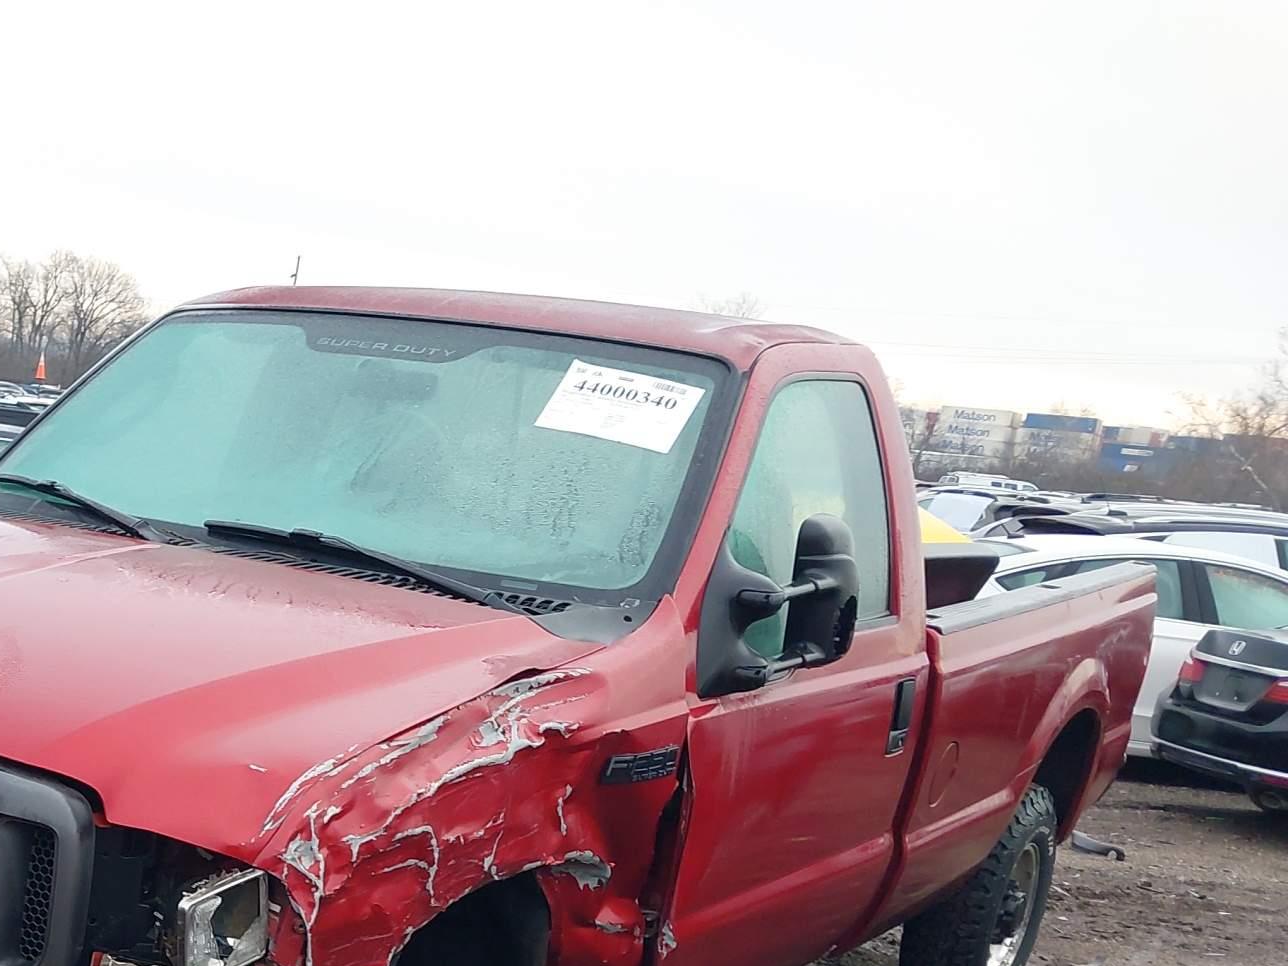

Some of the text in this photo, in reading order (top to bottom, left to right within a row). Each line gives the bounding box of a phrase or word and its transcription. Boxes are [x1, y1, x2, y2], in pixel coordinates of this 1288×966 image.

[316, 337, 457, 357] SUPER DUTY
[573, 379, 678, 411] 44000340
[953, 409, 996, 422] Matson
[947, 424, 990, 438] Matson
